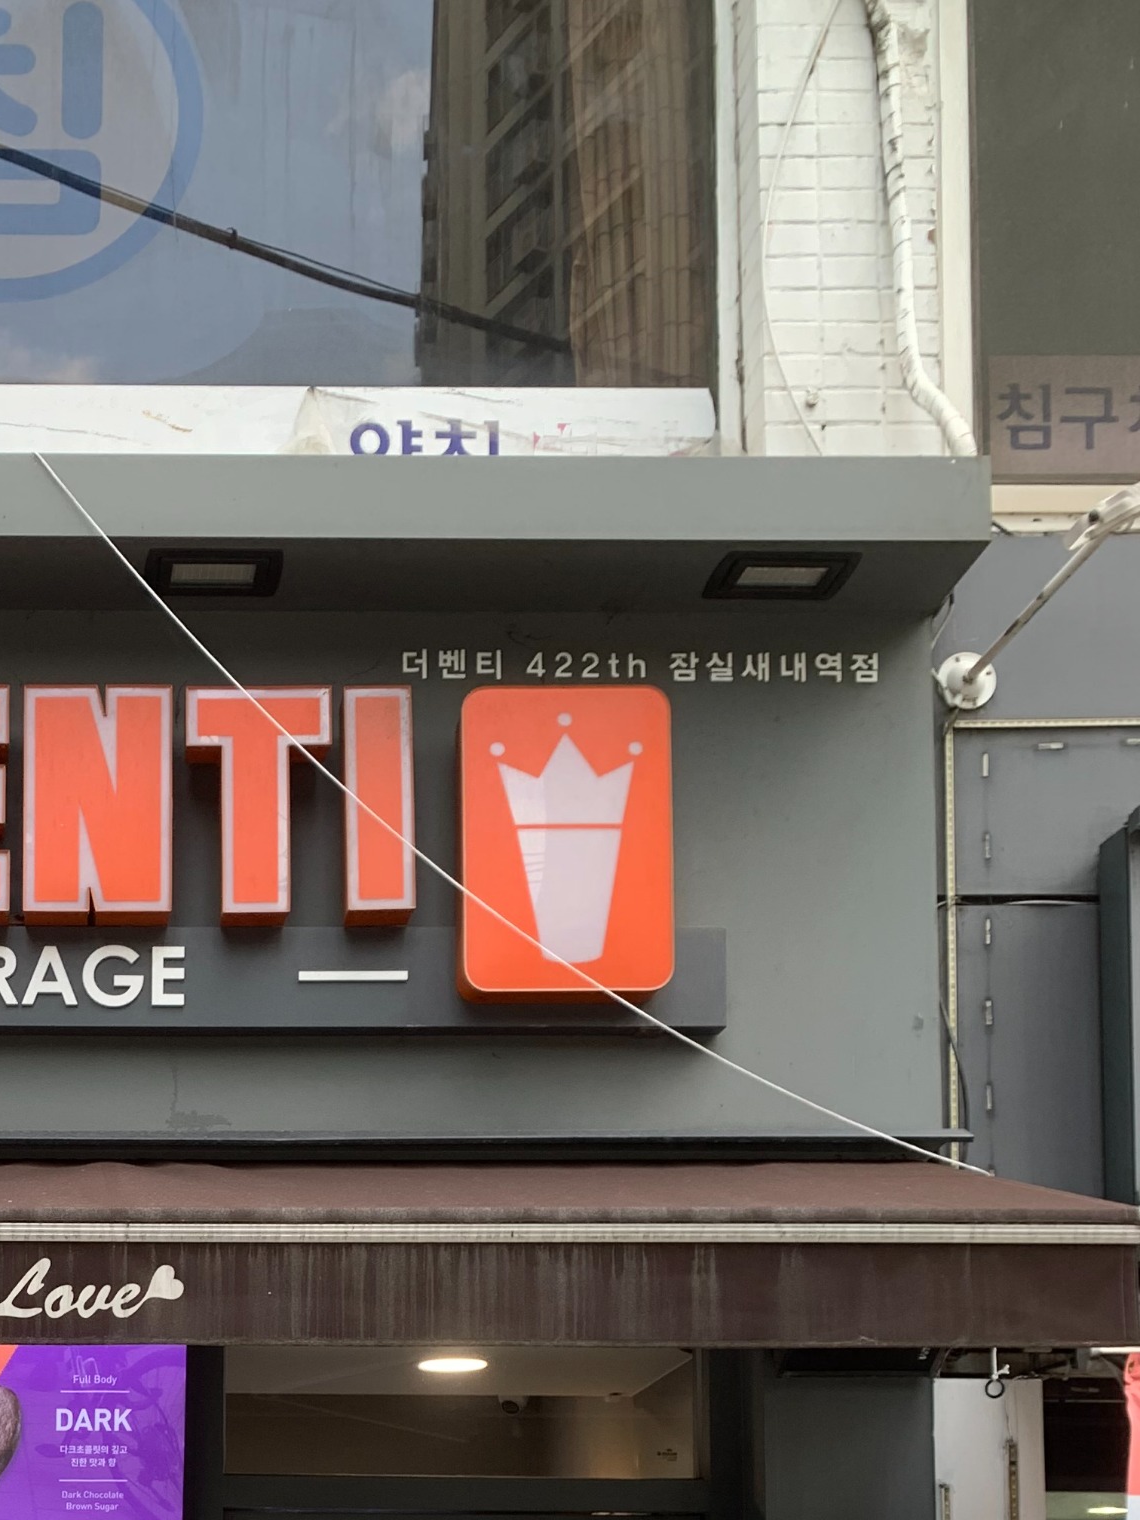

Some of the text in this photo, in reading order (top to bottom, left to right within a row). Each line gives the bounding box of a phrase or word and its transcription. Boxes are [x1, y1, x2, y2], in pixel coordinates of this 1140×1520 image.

[401, 649, 882, 684] 더벤티 422th 잠실새내역점
[73, 1374, 118, 1387] Full Body
[55, 1408, 133, 1432] DARK
[111, 1445, 128, 1455] 깊고
[71, 1457, 117, 1468] 진한 맛과 향
[61, 1490, 125, 1500] Dark Chocolate
[66, 1502, 119, 1513] Brown Sugar
